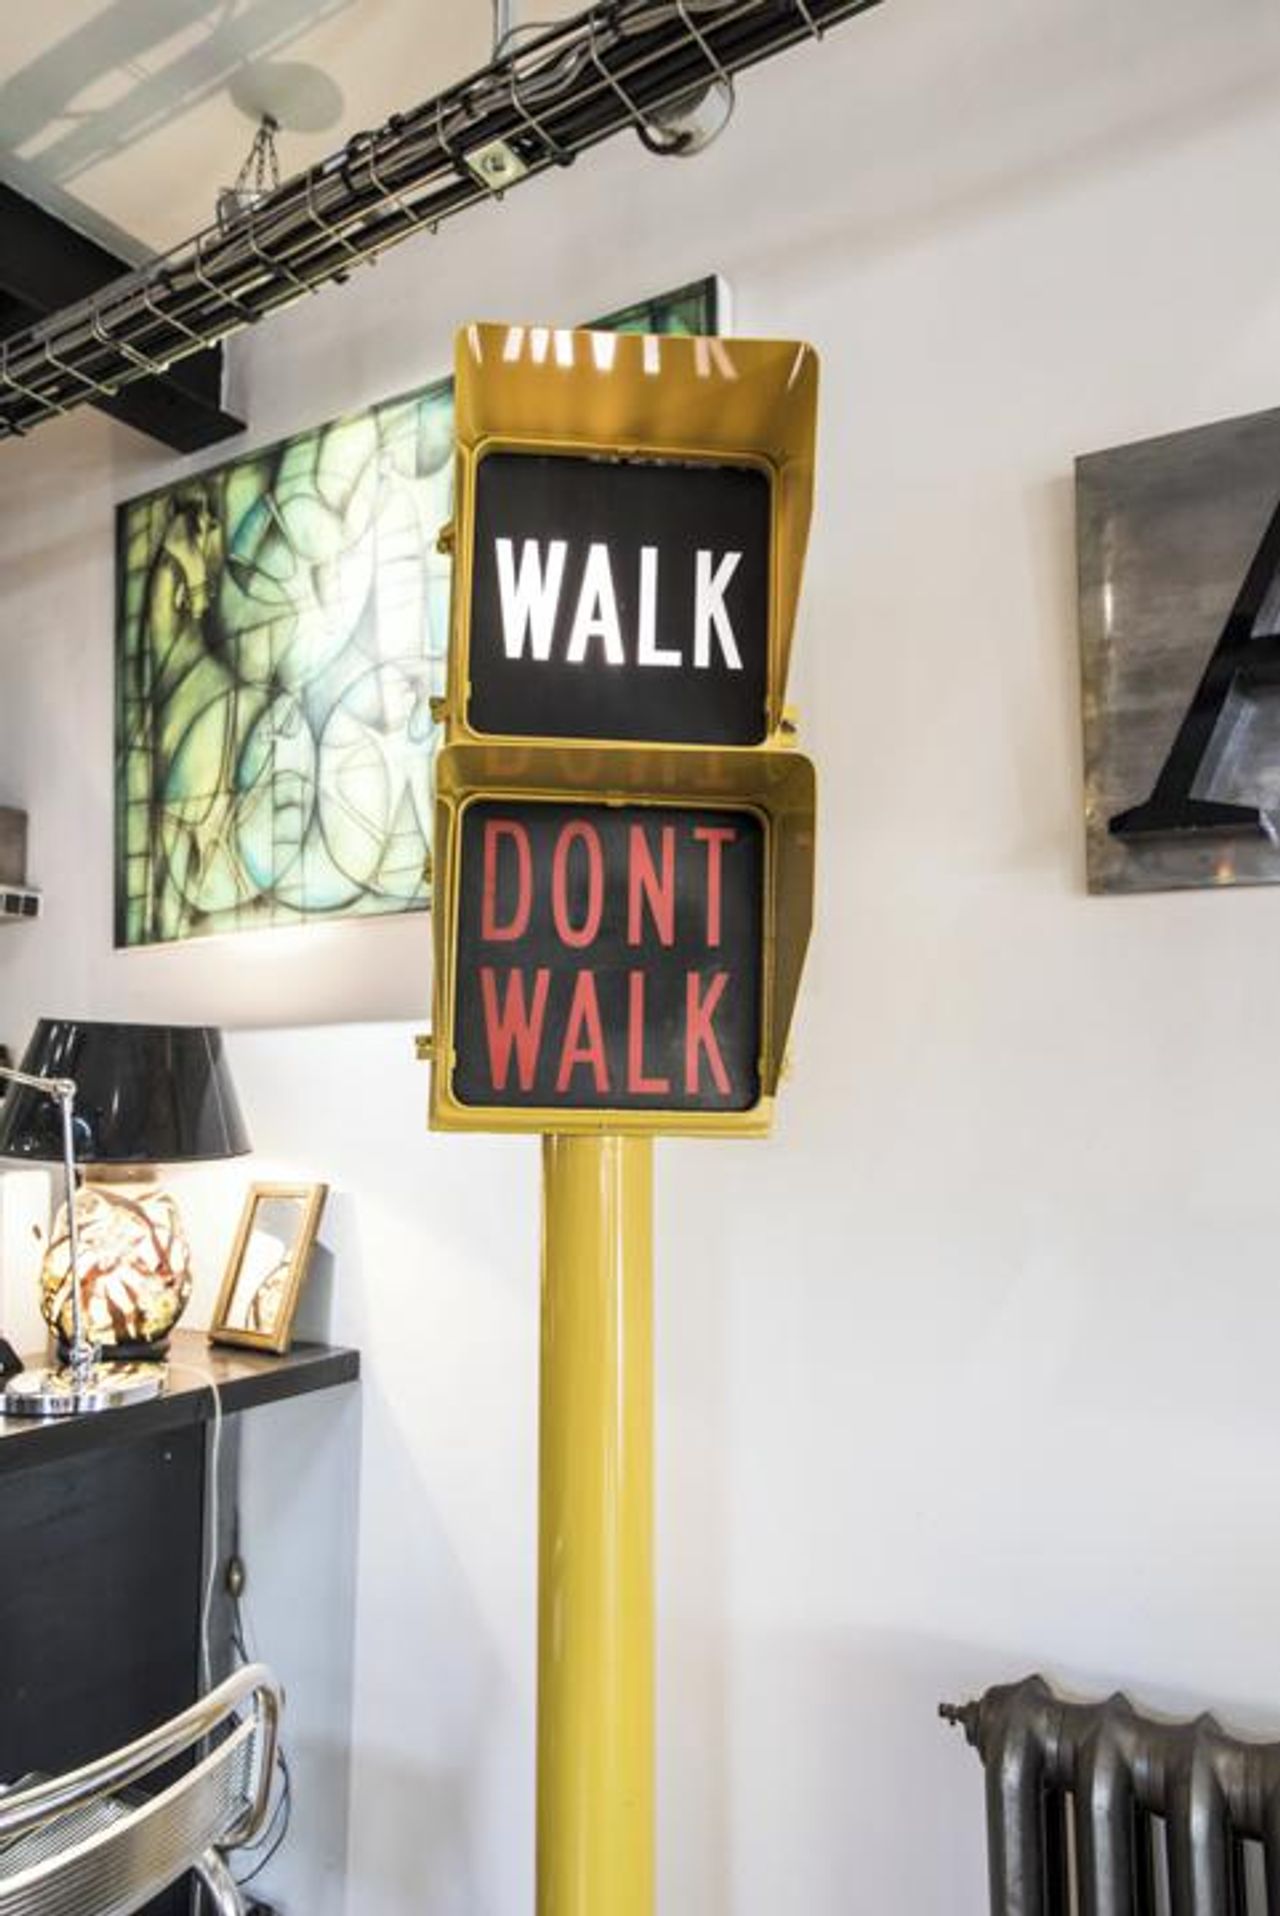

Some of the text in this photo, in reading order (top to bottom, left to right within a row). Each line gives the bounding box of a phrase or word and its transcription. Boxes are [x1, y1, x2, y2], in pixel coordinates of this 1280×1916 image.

[495, 537, 744, 670] WALK
[481, 819, 736, 948] DONT
[478, 967, 732, 1096] WALK
